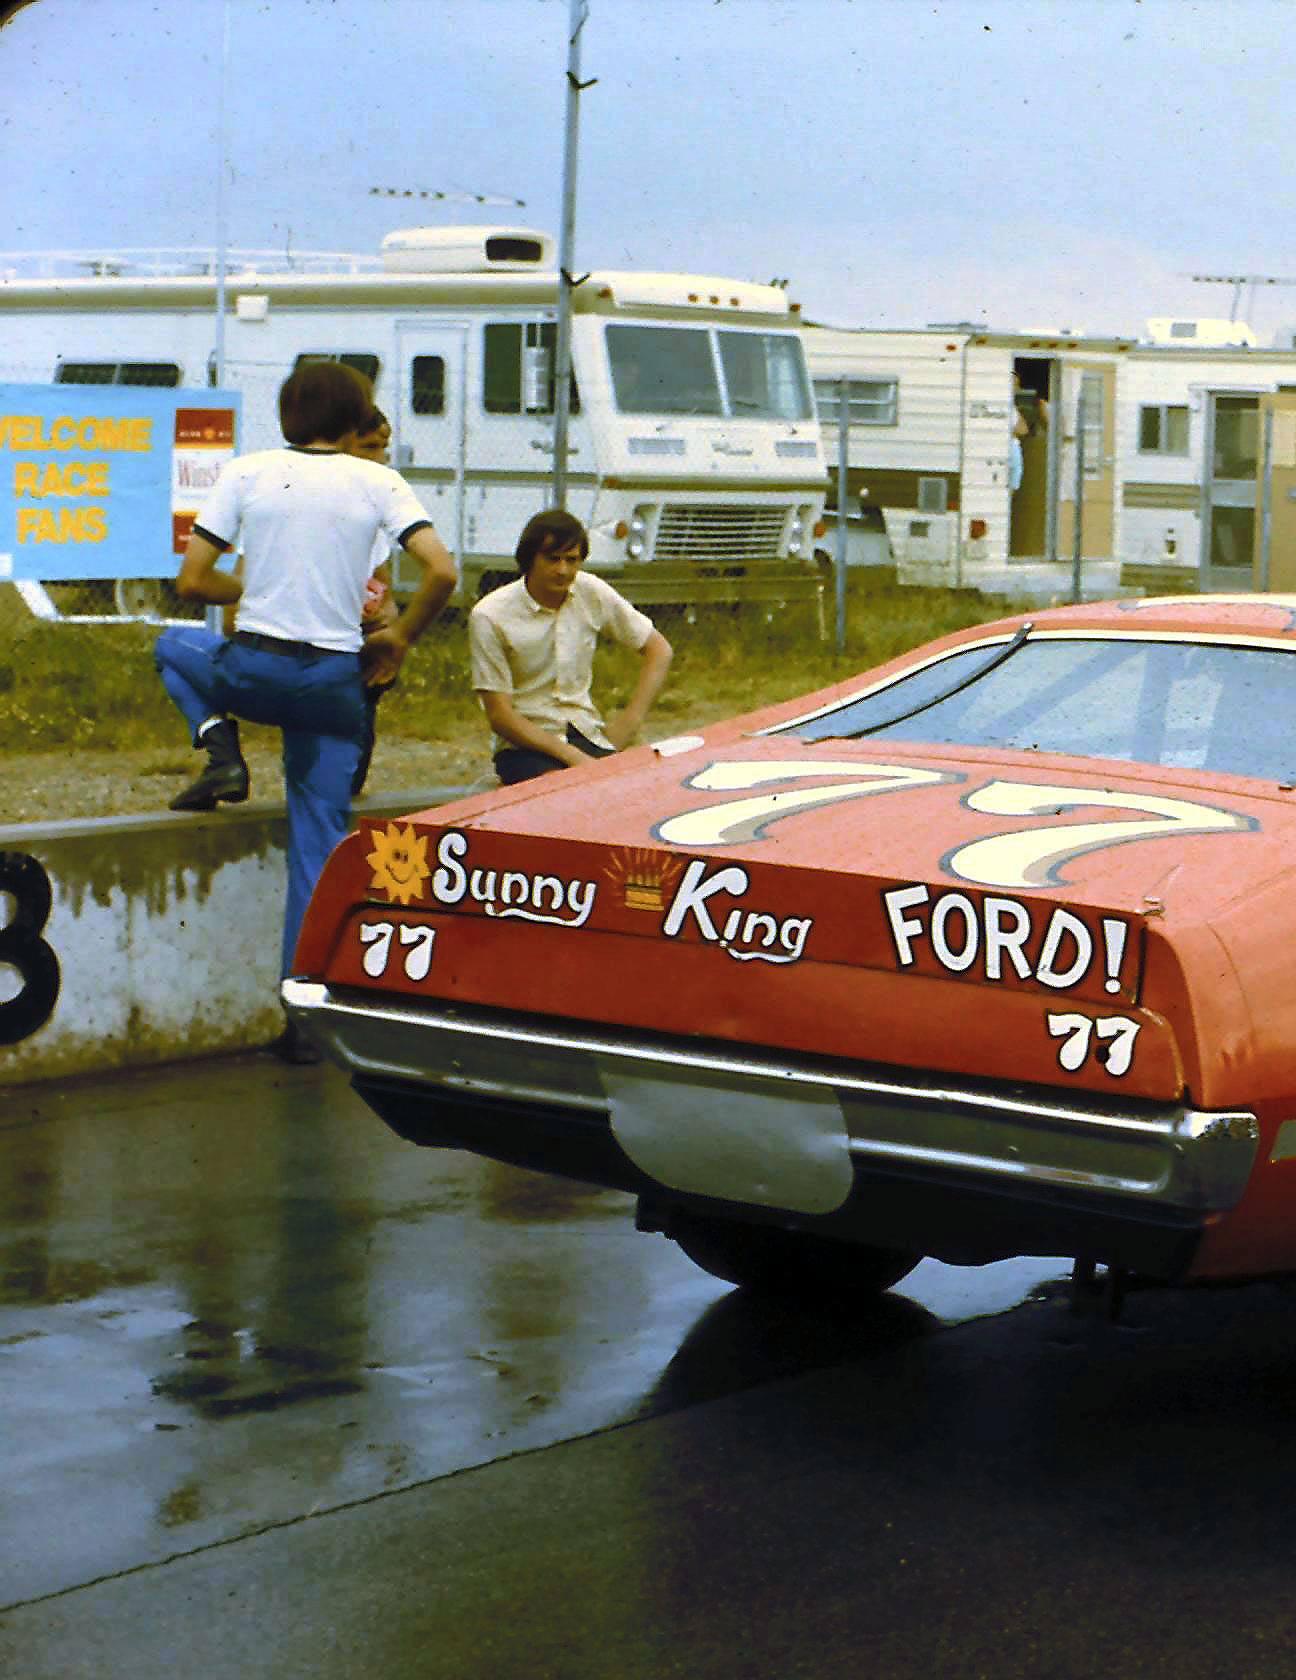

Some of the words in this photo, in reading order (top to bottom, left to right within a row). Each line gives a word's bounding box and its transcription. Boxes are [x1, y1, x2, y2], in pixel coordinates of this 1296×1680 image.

[14, 461, 109, 498] RACE
[16, 507, 107, 545] FANS
[656, 758, 1262, 889] 77
[432, 832, 597, 928] Sunny
[662, 860, 813, 964] King
[884, 884, 1128, 994] FORD!
[359, 922, 436, 981] 77
[1047, 1013, 1141, 1076] 77
